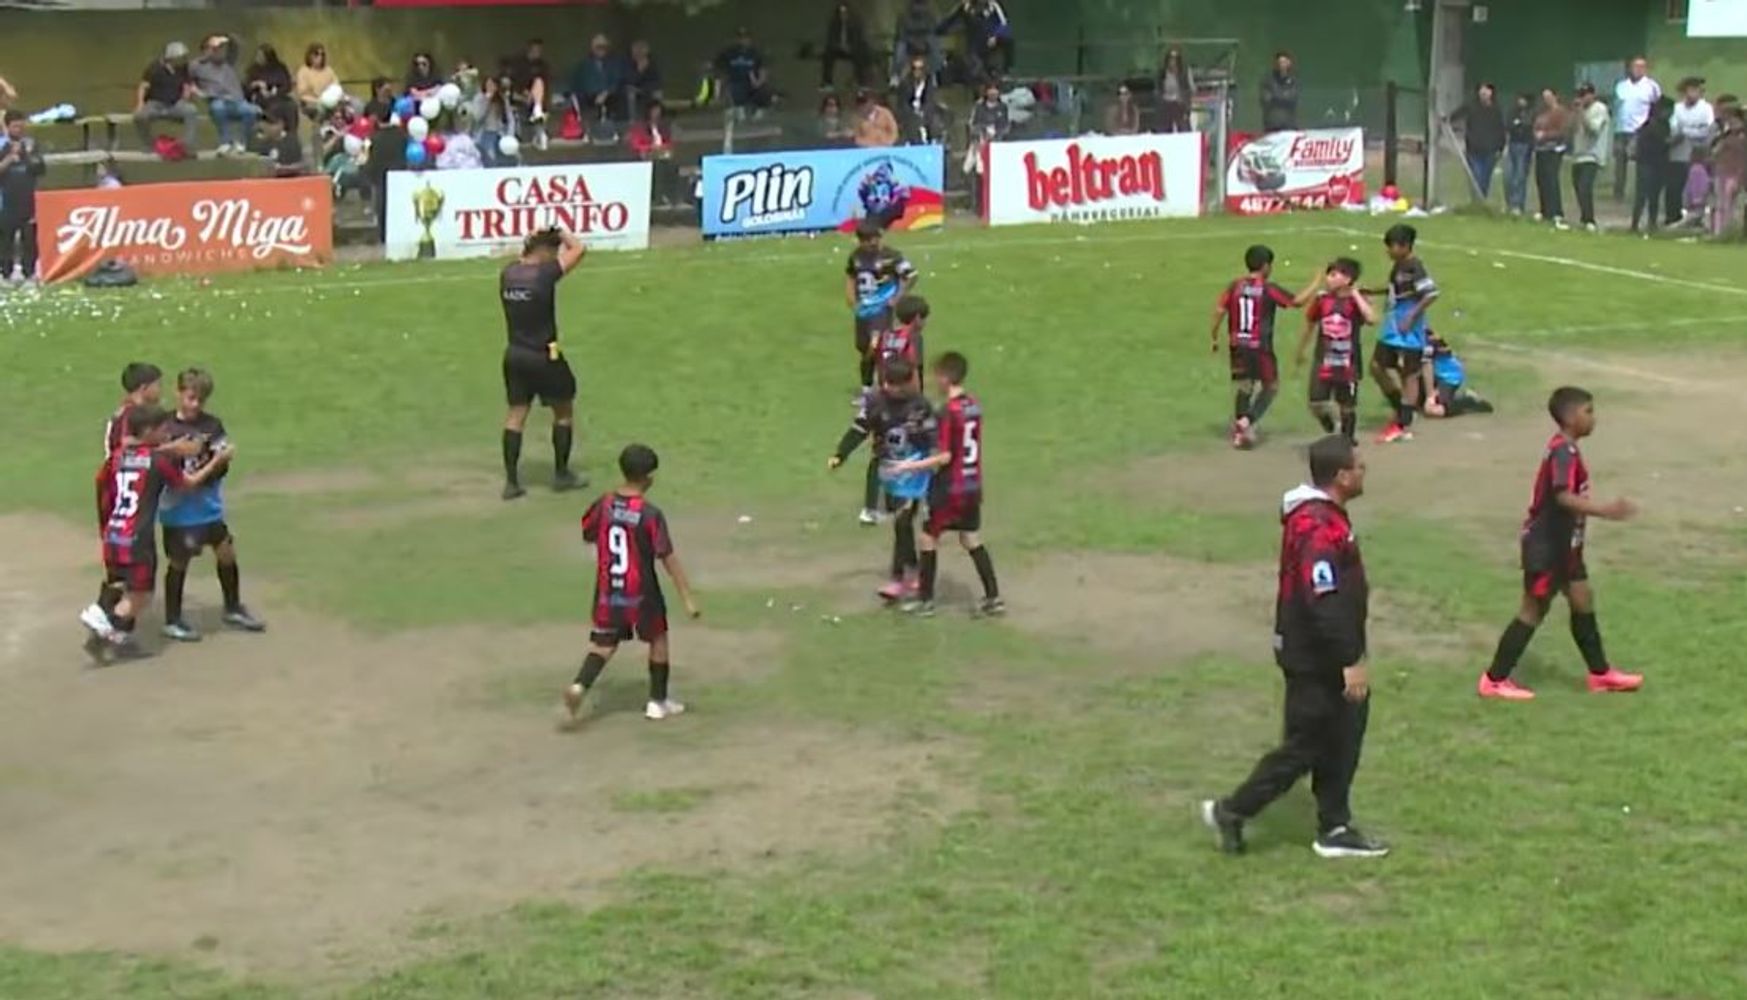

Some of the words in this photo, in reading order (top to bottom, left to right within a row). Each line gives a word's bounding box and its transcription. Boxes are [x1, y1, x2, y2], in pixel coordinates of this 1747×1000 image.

[1289, 136, 1355, 164] Family
[496, 174, 593, 206] CASA
[720, 163, 813, 223] Plin
[1023, 143, 1165, 211] beltran
[56, 206, 187, 254] Alma
[192, 198, 312, 259] Miga
[455, 202, 629, 240] TRIUNFO
[1239, 297, 1254, 331] 11
[962, 421, 978, 464] 5
[113, 471, 140, 518] 15
[608, 525, 629, 575] 9
